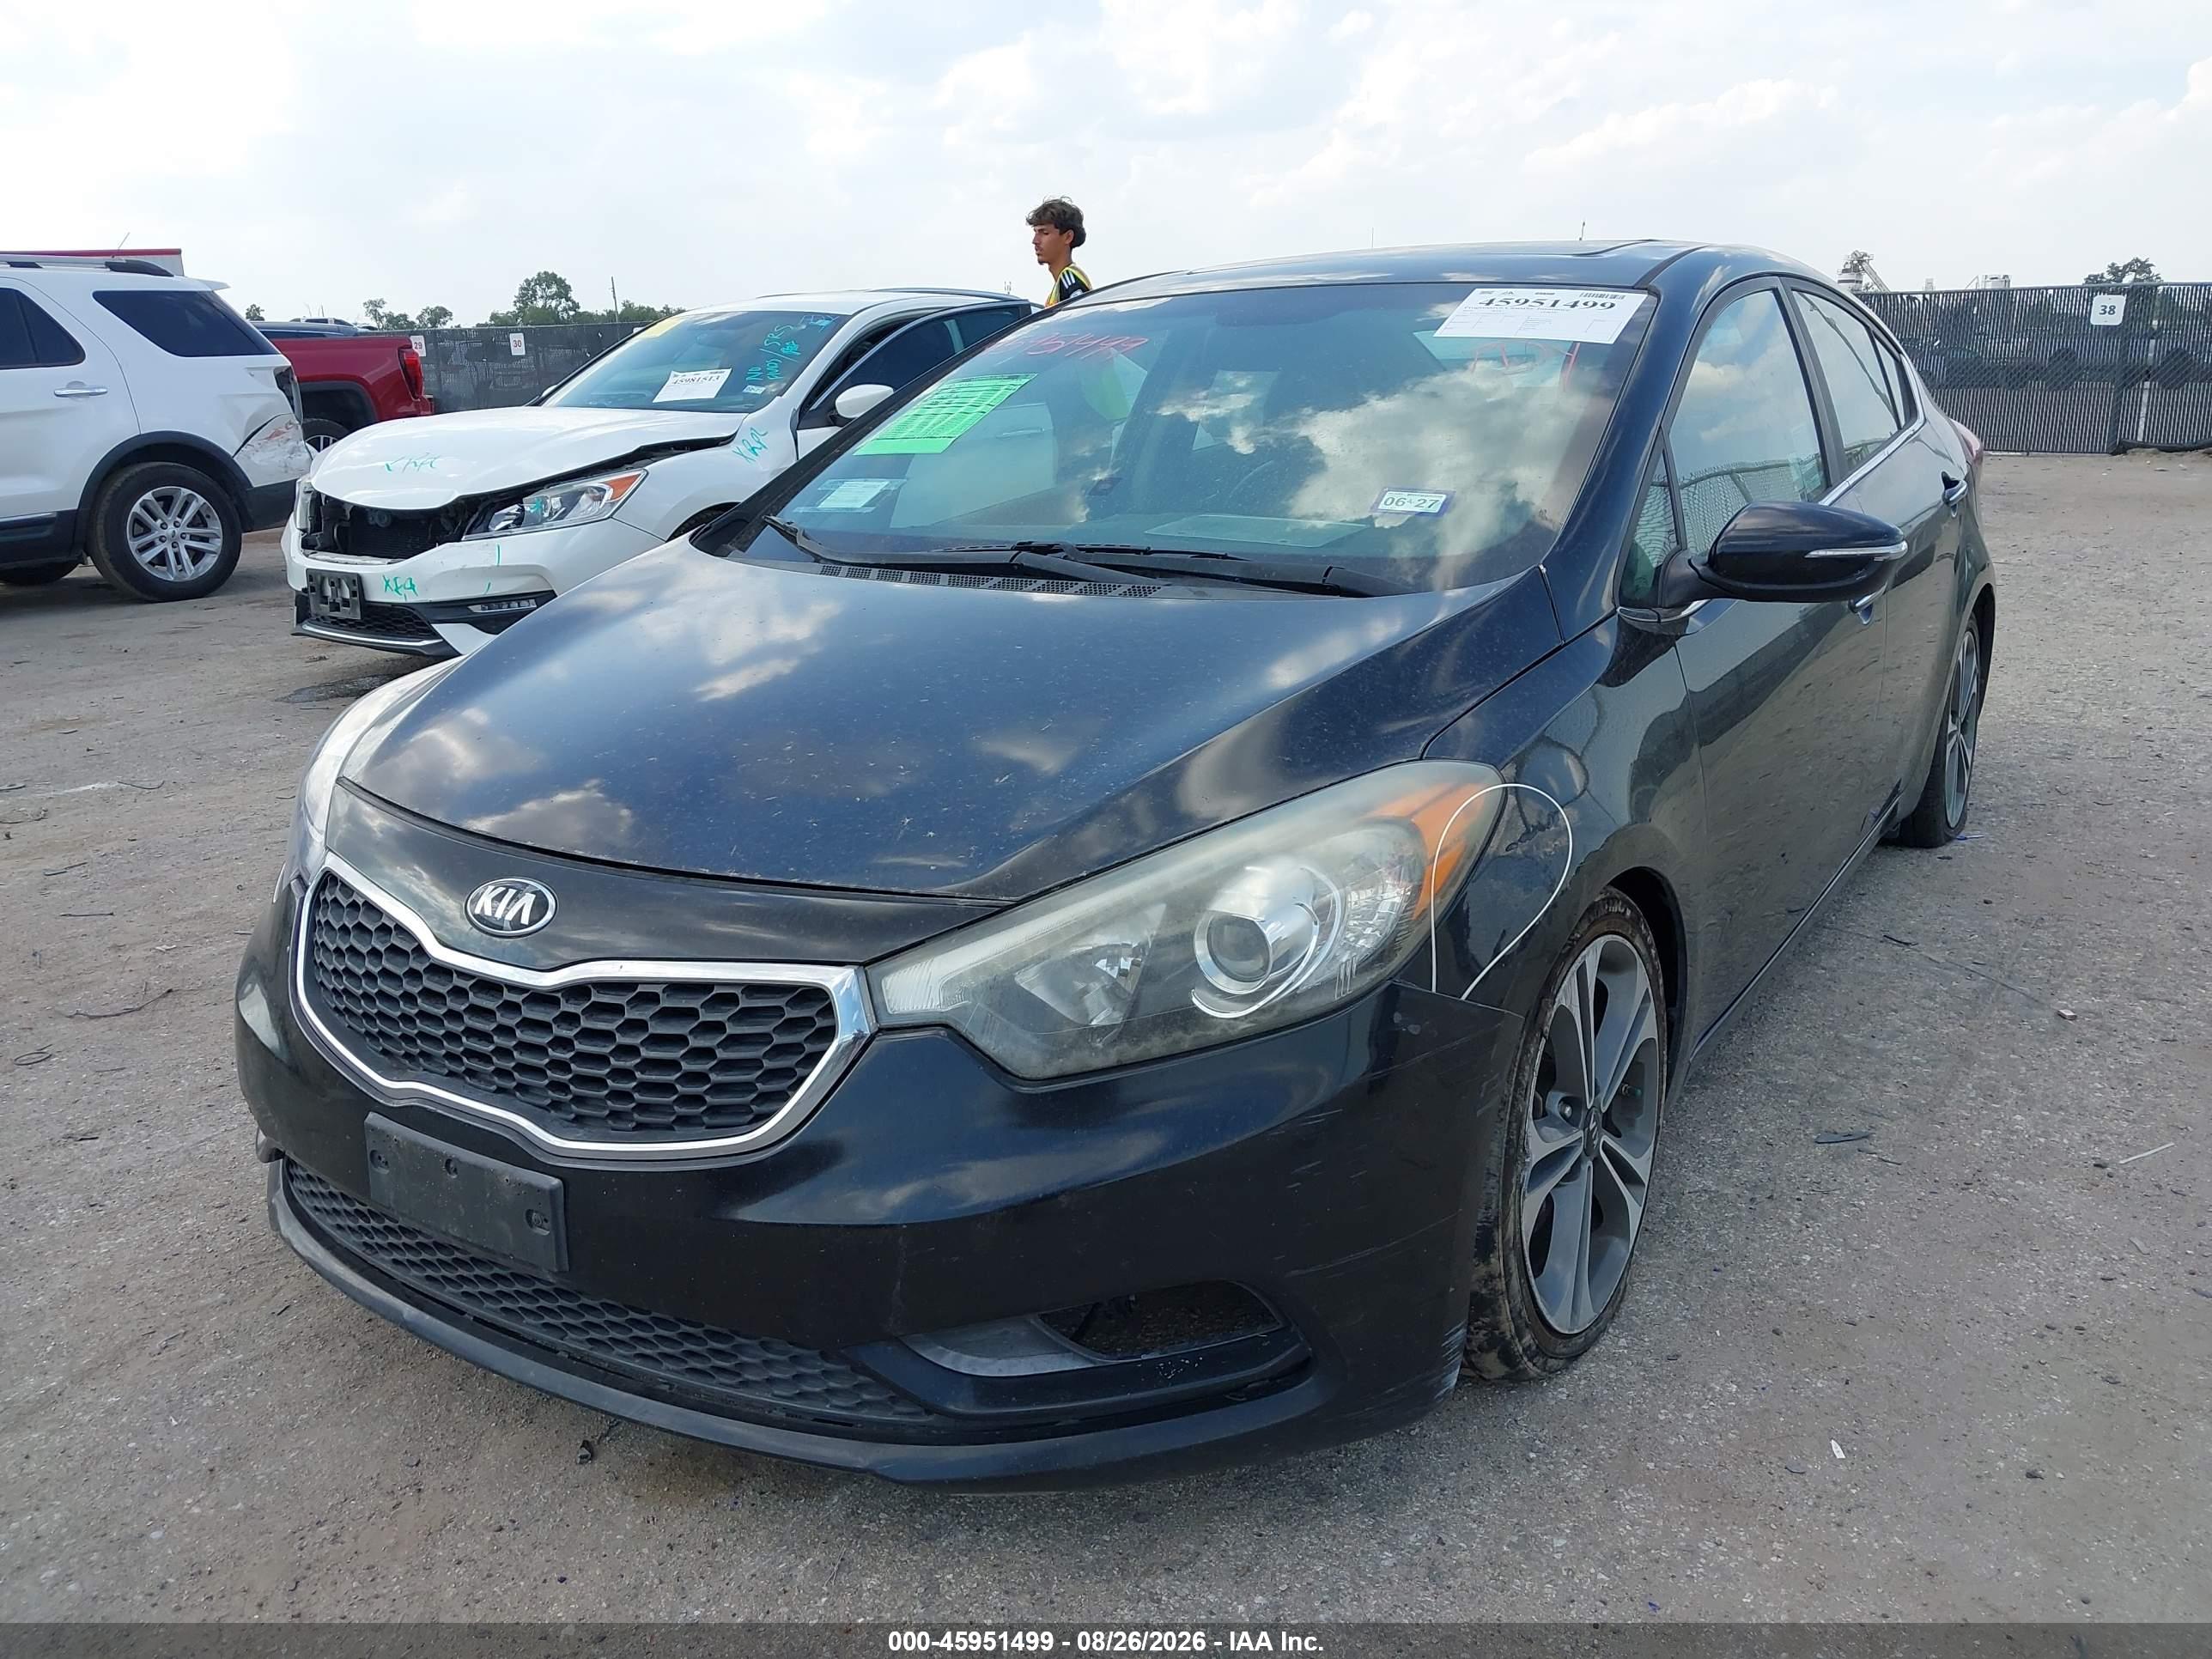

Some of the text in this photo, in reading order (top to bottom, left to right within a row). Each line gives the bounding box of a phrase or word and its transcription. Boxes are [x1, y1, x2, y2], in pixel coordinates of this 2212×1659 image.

[1478, 297, 1616, 311] 45951499
[2099, 304, 2117, 315] 38
[513, 339, 522, 348] 30
[1383, 496, 1440, 508] 06 27
[474, 885, 537, 926] KIA
